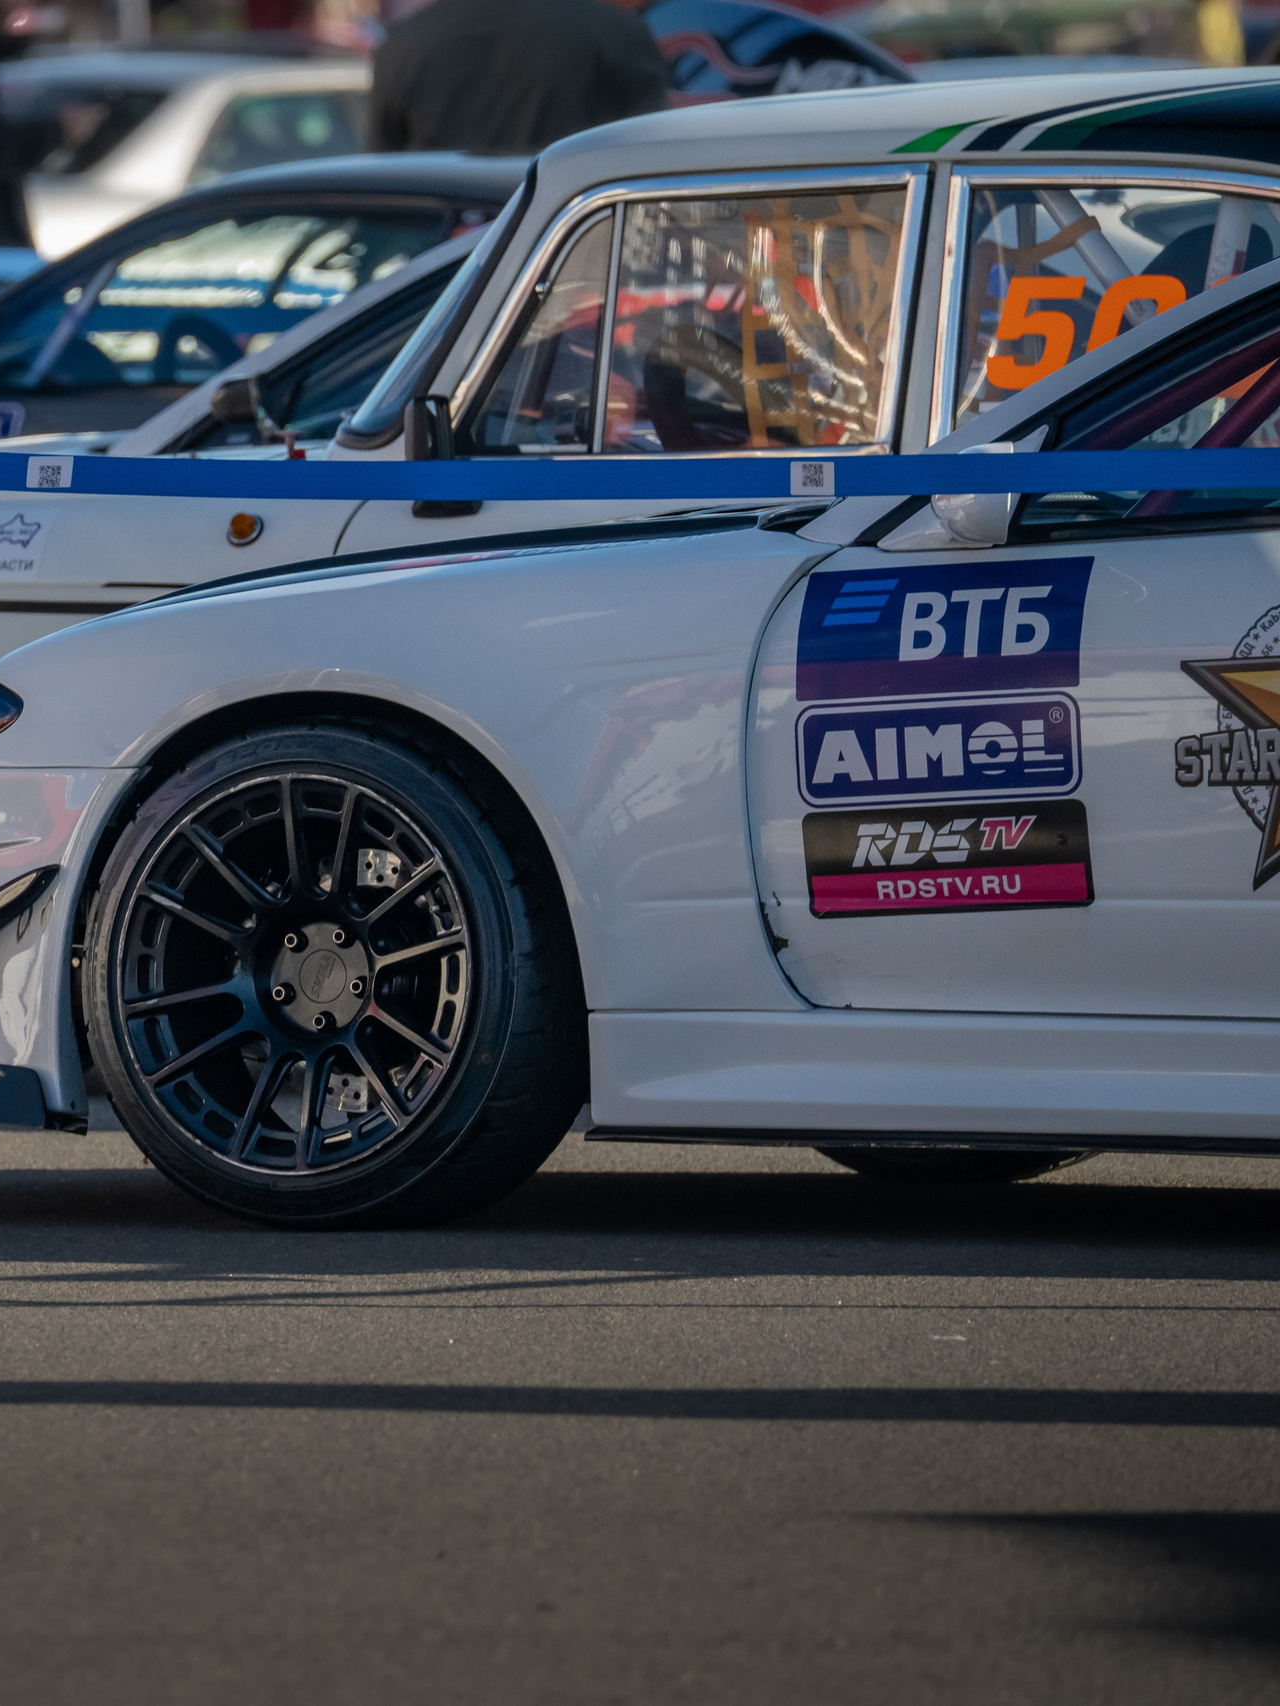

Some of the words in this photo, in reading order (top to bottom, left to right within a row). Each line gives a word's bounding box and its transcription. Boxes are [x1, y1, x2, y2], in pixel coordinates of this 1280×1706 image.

[986, 274, 1240, 390] 50
[899, 585, 1053, 662] ВТБ
[812, 719, 1065, 785] AIMOL
[979, 815, 1037, 851] TV
[877, 874, 1021, 900] RDSTV.RU
